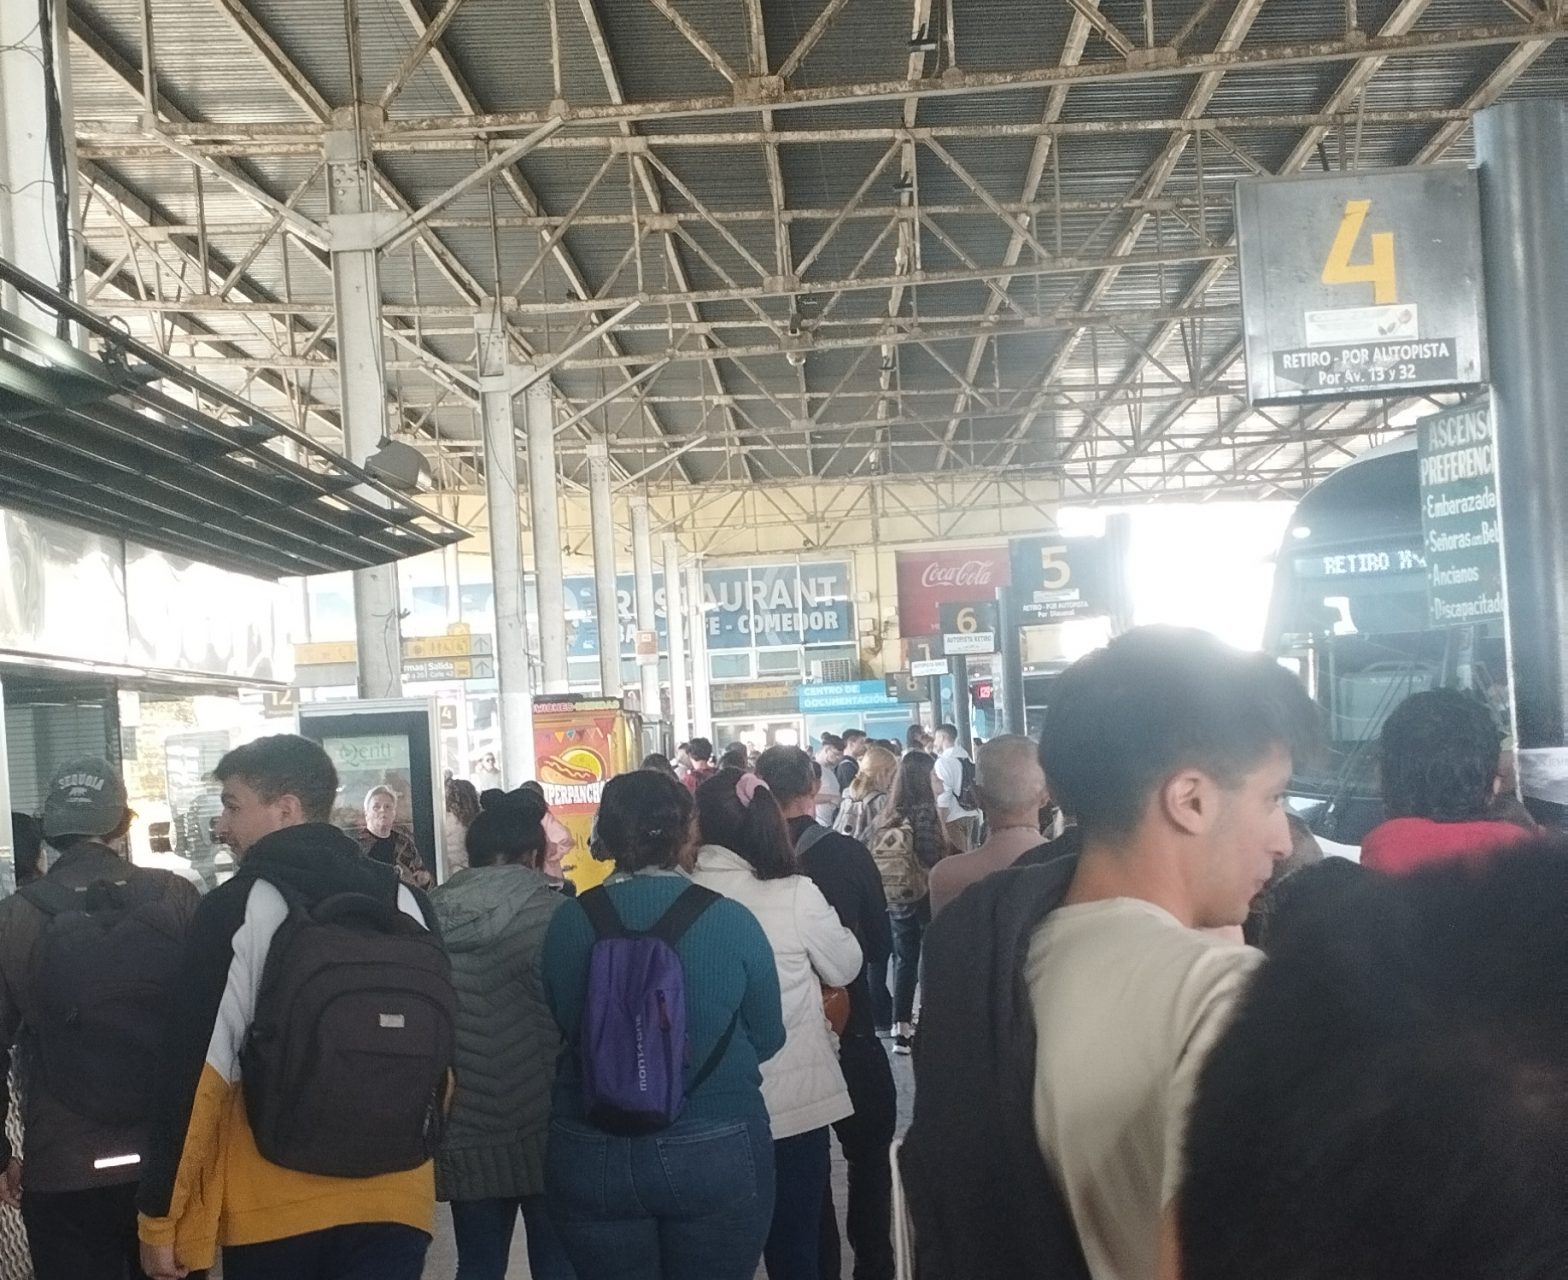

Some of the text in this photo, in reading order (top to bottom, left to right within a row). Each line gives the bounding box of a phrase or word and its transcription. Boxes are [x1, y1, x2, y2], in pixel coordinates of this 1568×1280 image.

[1322, 199, 1397, 304] 4
[1283, 351, 1331, 369] RETIRO
[1342, 349, 1369, 365] POR
[1373, 343, 1450, 362] AUTOPISTA
[1319, 365, 1416, 385] Por Av. 13 y 32
[1427, 485, 1496, 518] Embarazada
[1429, 529, 1471, 552] Señoras
[922, 560, 994, 588] Coca-Cola
[1041, 545, 1071, 589] 5
[1323, 552, 1390, 574] RETIRO
[1433, 563, 1479, 586] Ancianos
[738, 611, 839, 634] COMEDOR
[957, 607, 977, 634] 6
[803, 684, 859, 696] CENTRO DE
[441, 706, 451, 719] 4
